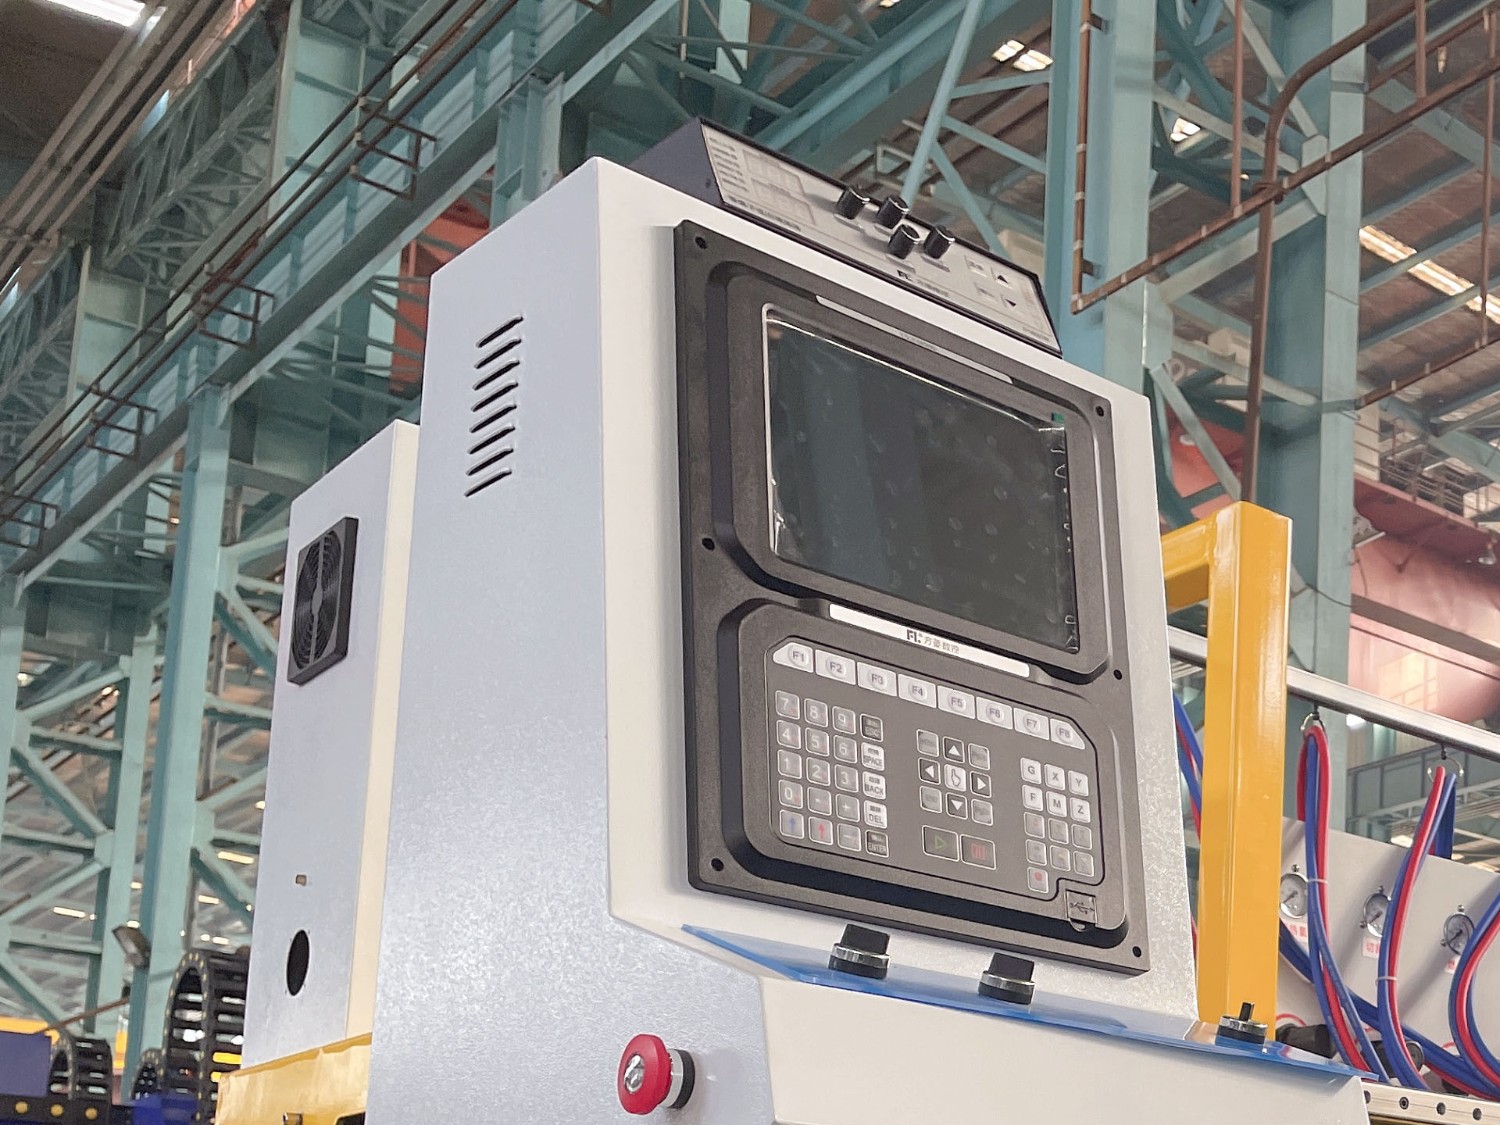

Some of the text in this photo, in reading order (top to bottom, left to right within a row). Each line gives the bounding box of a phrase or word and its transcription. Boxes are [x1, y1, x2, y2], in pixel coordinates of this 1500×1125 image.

[792, 651, 804, 662] F1
[829, 661, 842, 673] F2
[871, 674, 884, 685] F3
[912, 687, 924, 697] F4
[782, 698, 789, 710] 7
[951, 696, 963, 707] F5
[810, 706, 818, 719] 8
[989, 707, 1001, 718] F6
[838, 713, 846, 726] 9
[1026, 718, 1037, 729] F7
[782, 728, 790, 740] 4
[811, 735, 819, 748] 5
[840, 743, 848, 755] 6
[812, 765, 820, 778] 2
[1028, 766, 1035, 775] G
[840, 772, 849, 784] 3
[1052, 772, 1058, 781] X
[1075, 779, 1082, 787] Y
[865, 784, 884, 795] BACK
[869, 814, 884, 825] DEL
